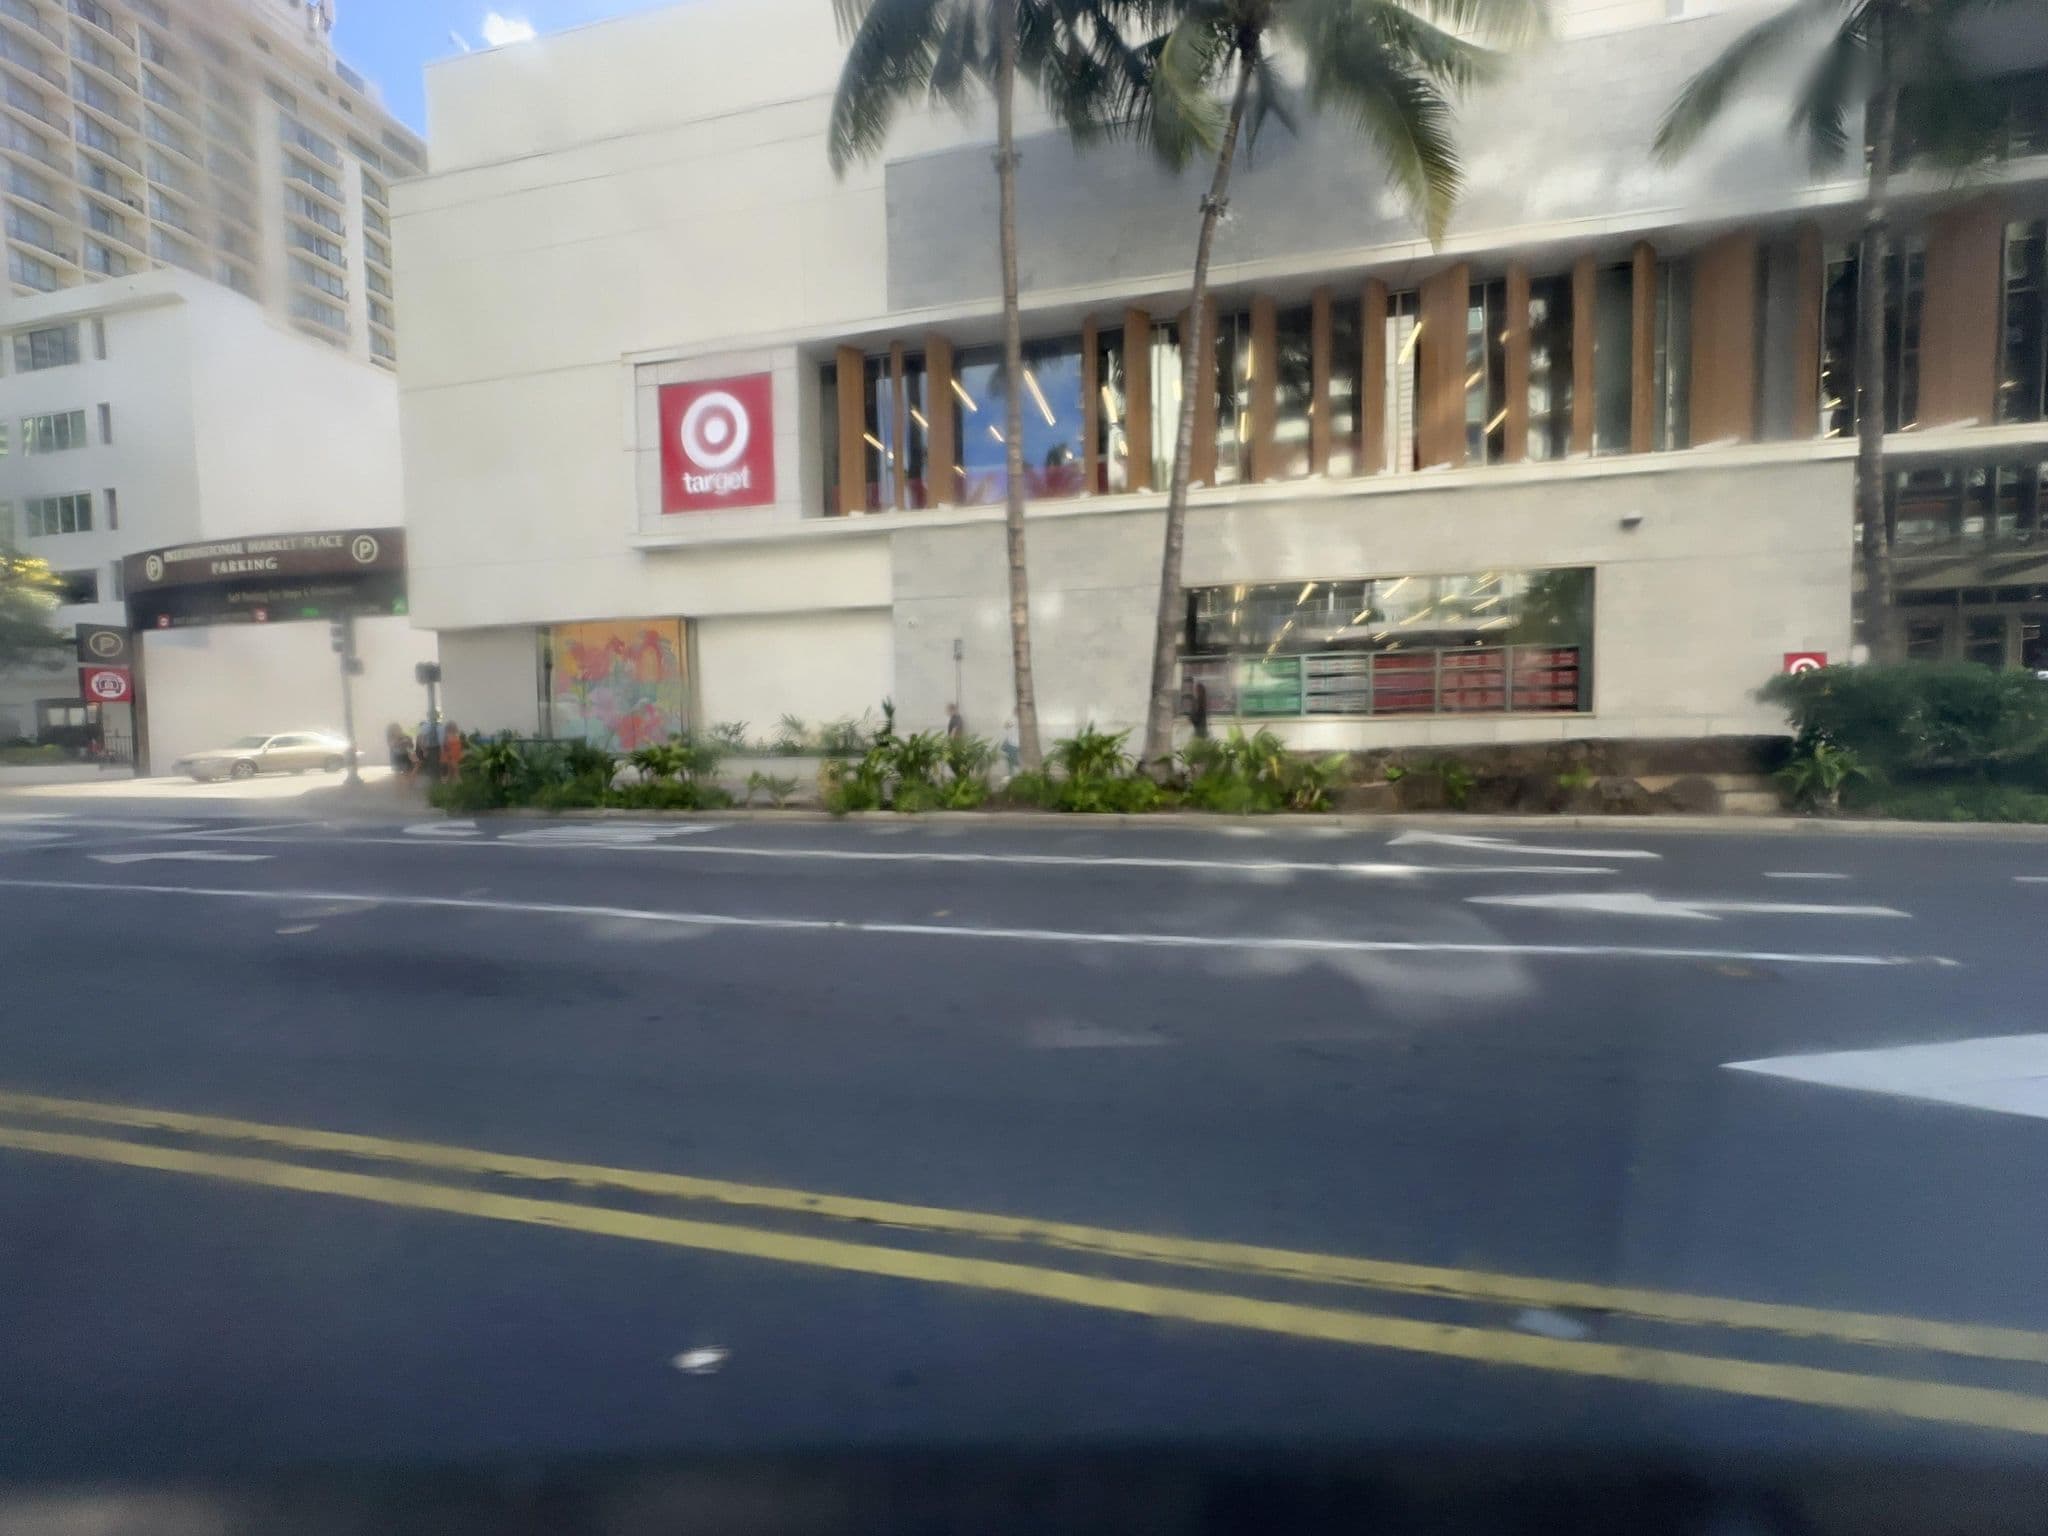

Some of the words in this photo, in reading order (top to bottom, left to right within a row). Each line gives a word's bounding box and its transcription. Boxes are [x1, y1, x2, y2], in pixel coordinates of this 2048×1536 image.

[682, 465, 751, 496] target
[303, 535, 344, 550] PLACE
[358, 541, 372, 559] P
[211, 557, 278, 575] PARKING
